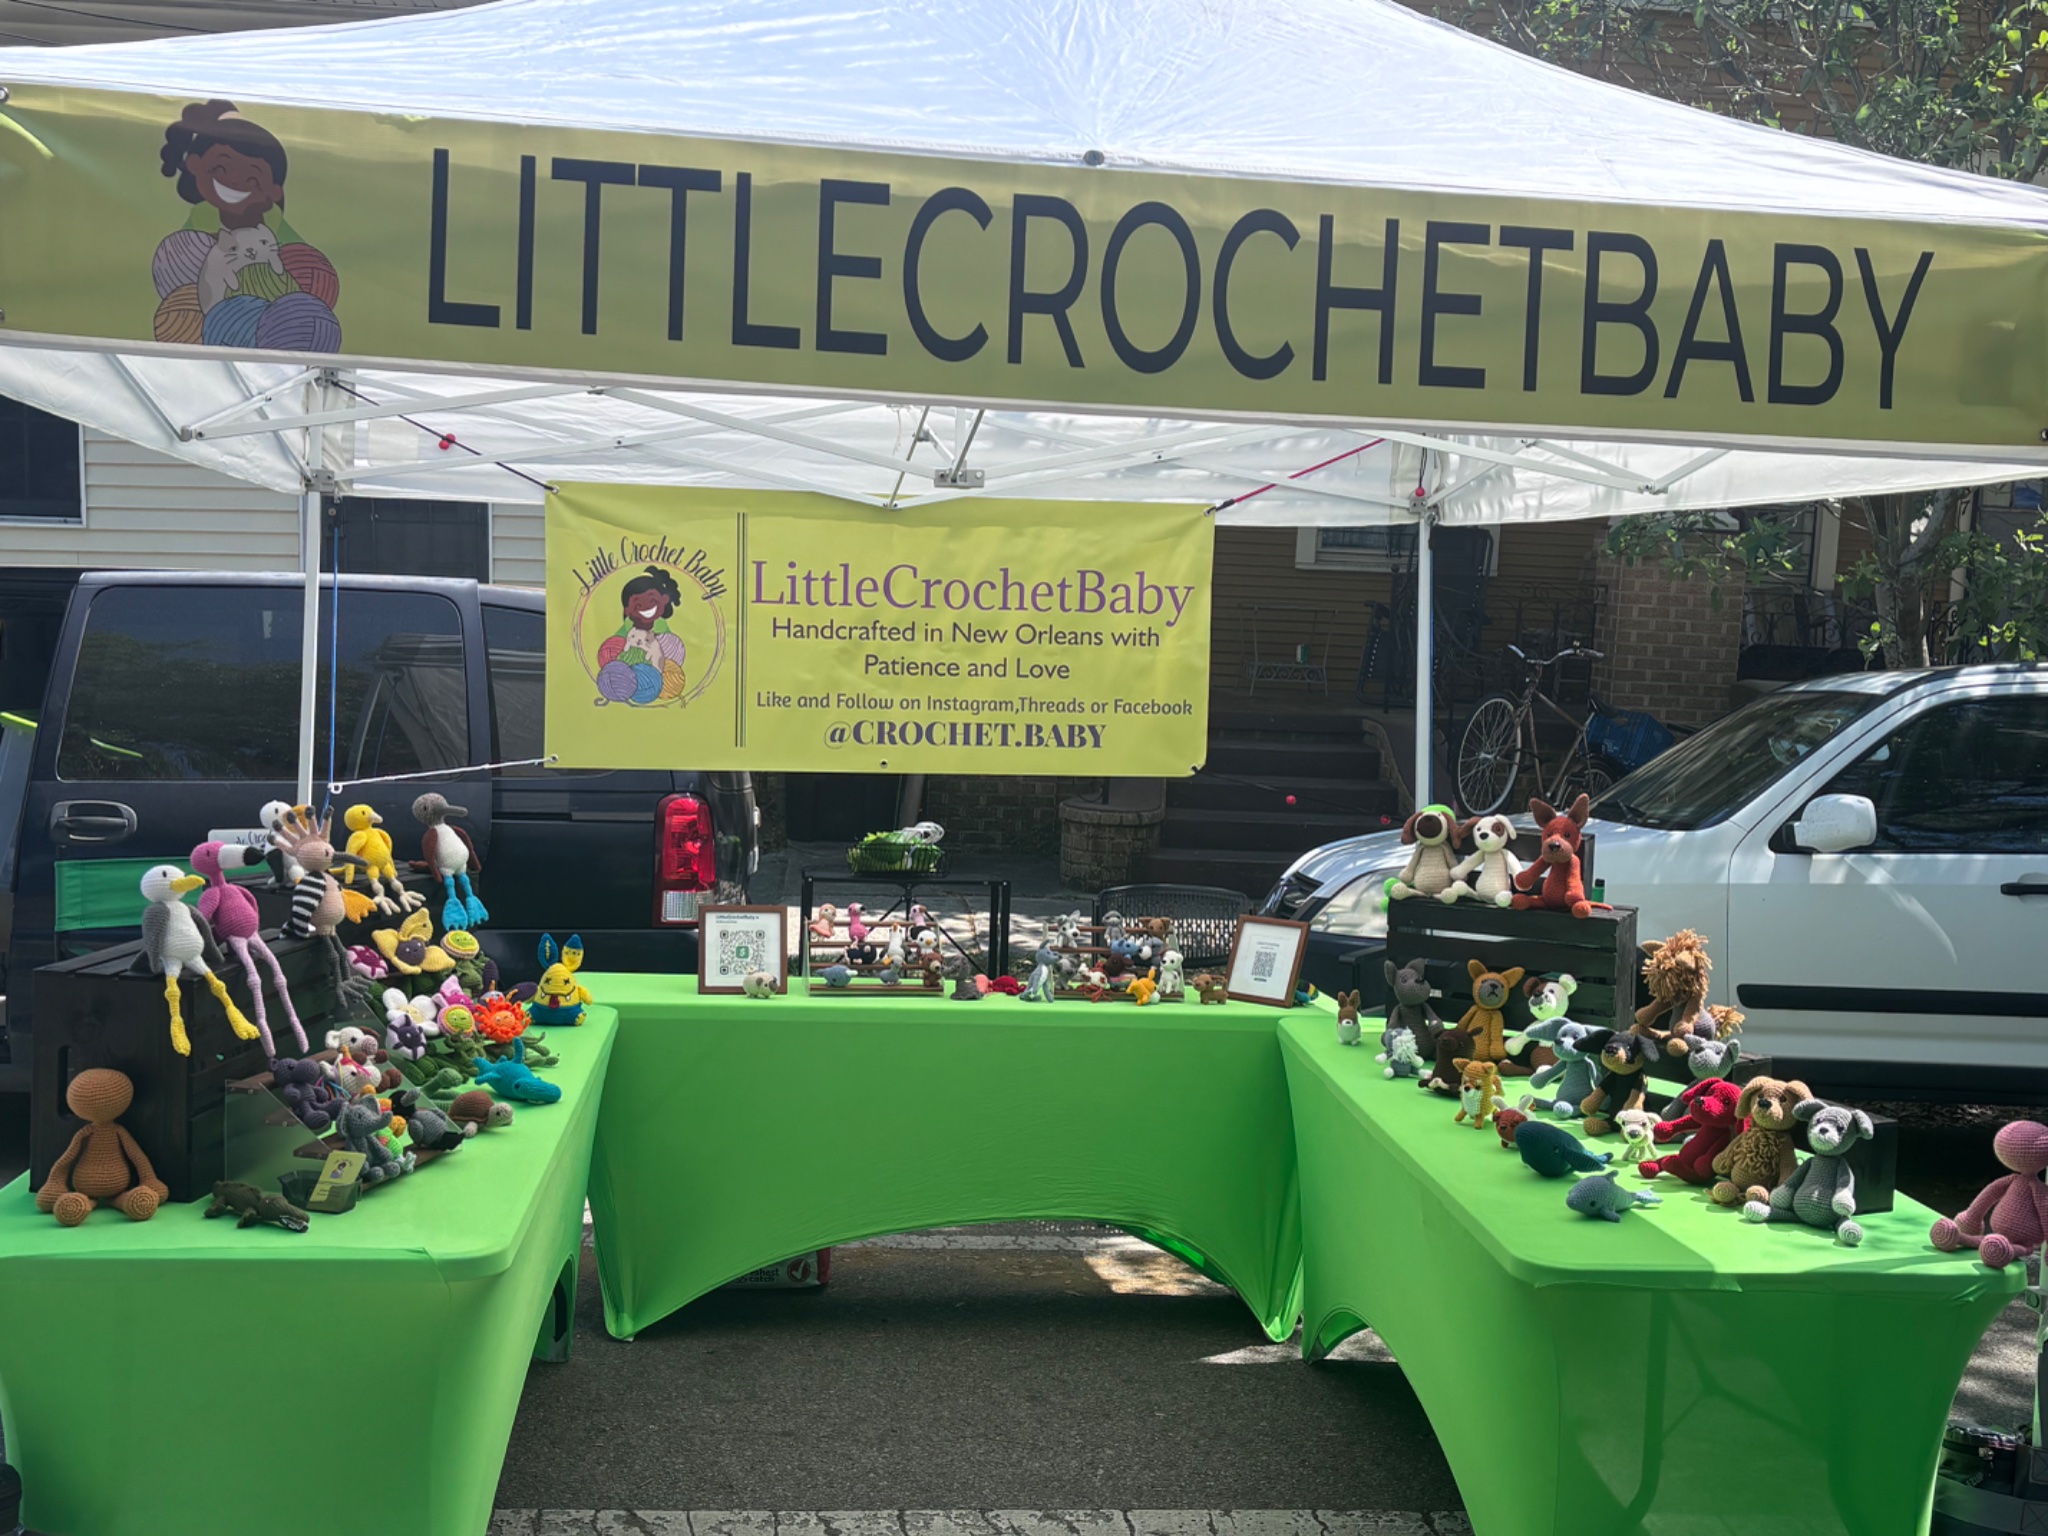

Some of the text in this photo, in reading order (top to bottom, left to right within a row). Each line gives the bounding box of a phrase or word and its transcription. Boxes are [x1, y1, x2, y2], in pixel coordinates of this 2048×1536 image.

[428, 148, 1934, 410] LITTLECROCHETBABY
[572, 535, 727, 601] Little Crochet Baby
[751, 561, 1195, 627] LittleCrochetBaby
[772, 617, 1160, 647] Handcrafted in New Orleans with
[864, 653, 1070, 679] Patience and Love
[757, 691, 792, 708] Like
[797, 692, 830, 709] and
[836, 693, 894, 710] Follow
[899, 697, 921, 710] on
[1090, 701, 1108, 714] or
[1113, 698, 1193, 715] Facebook
[824, 719, 1106, 750] @CROCHET.BABY
